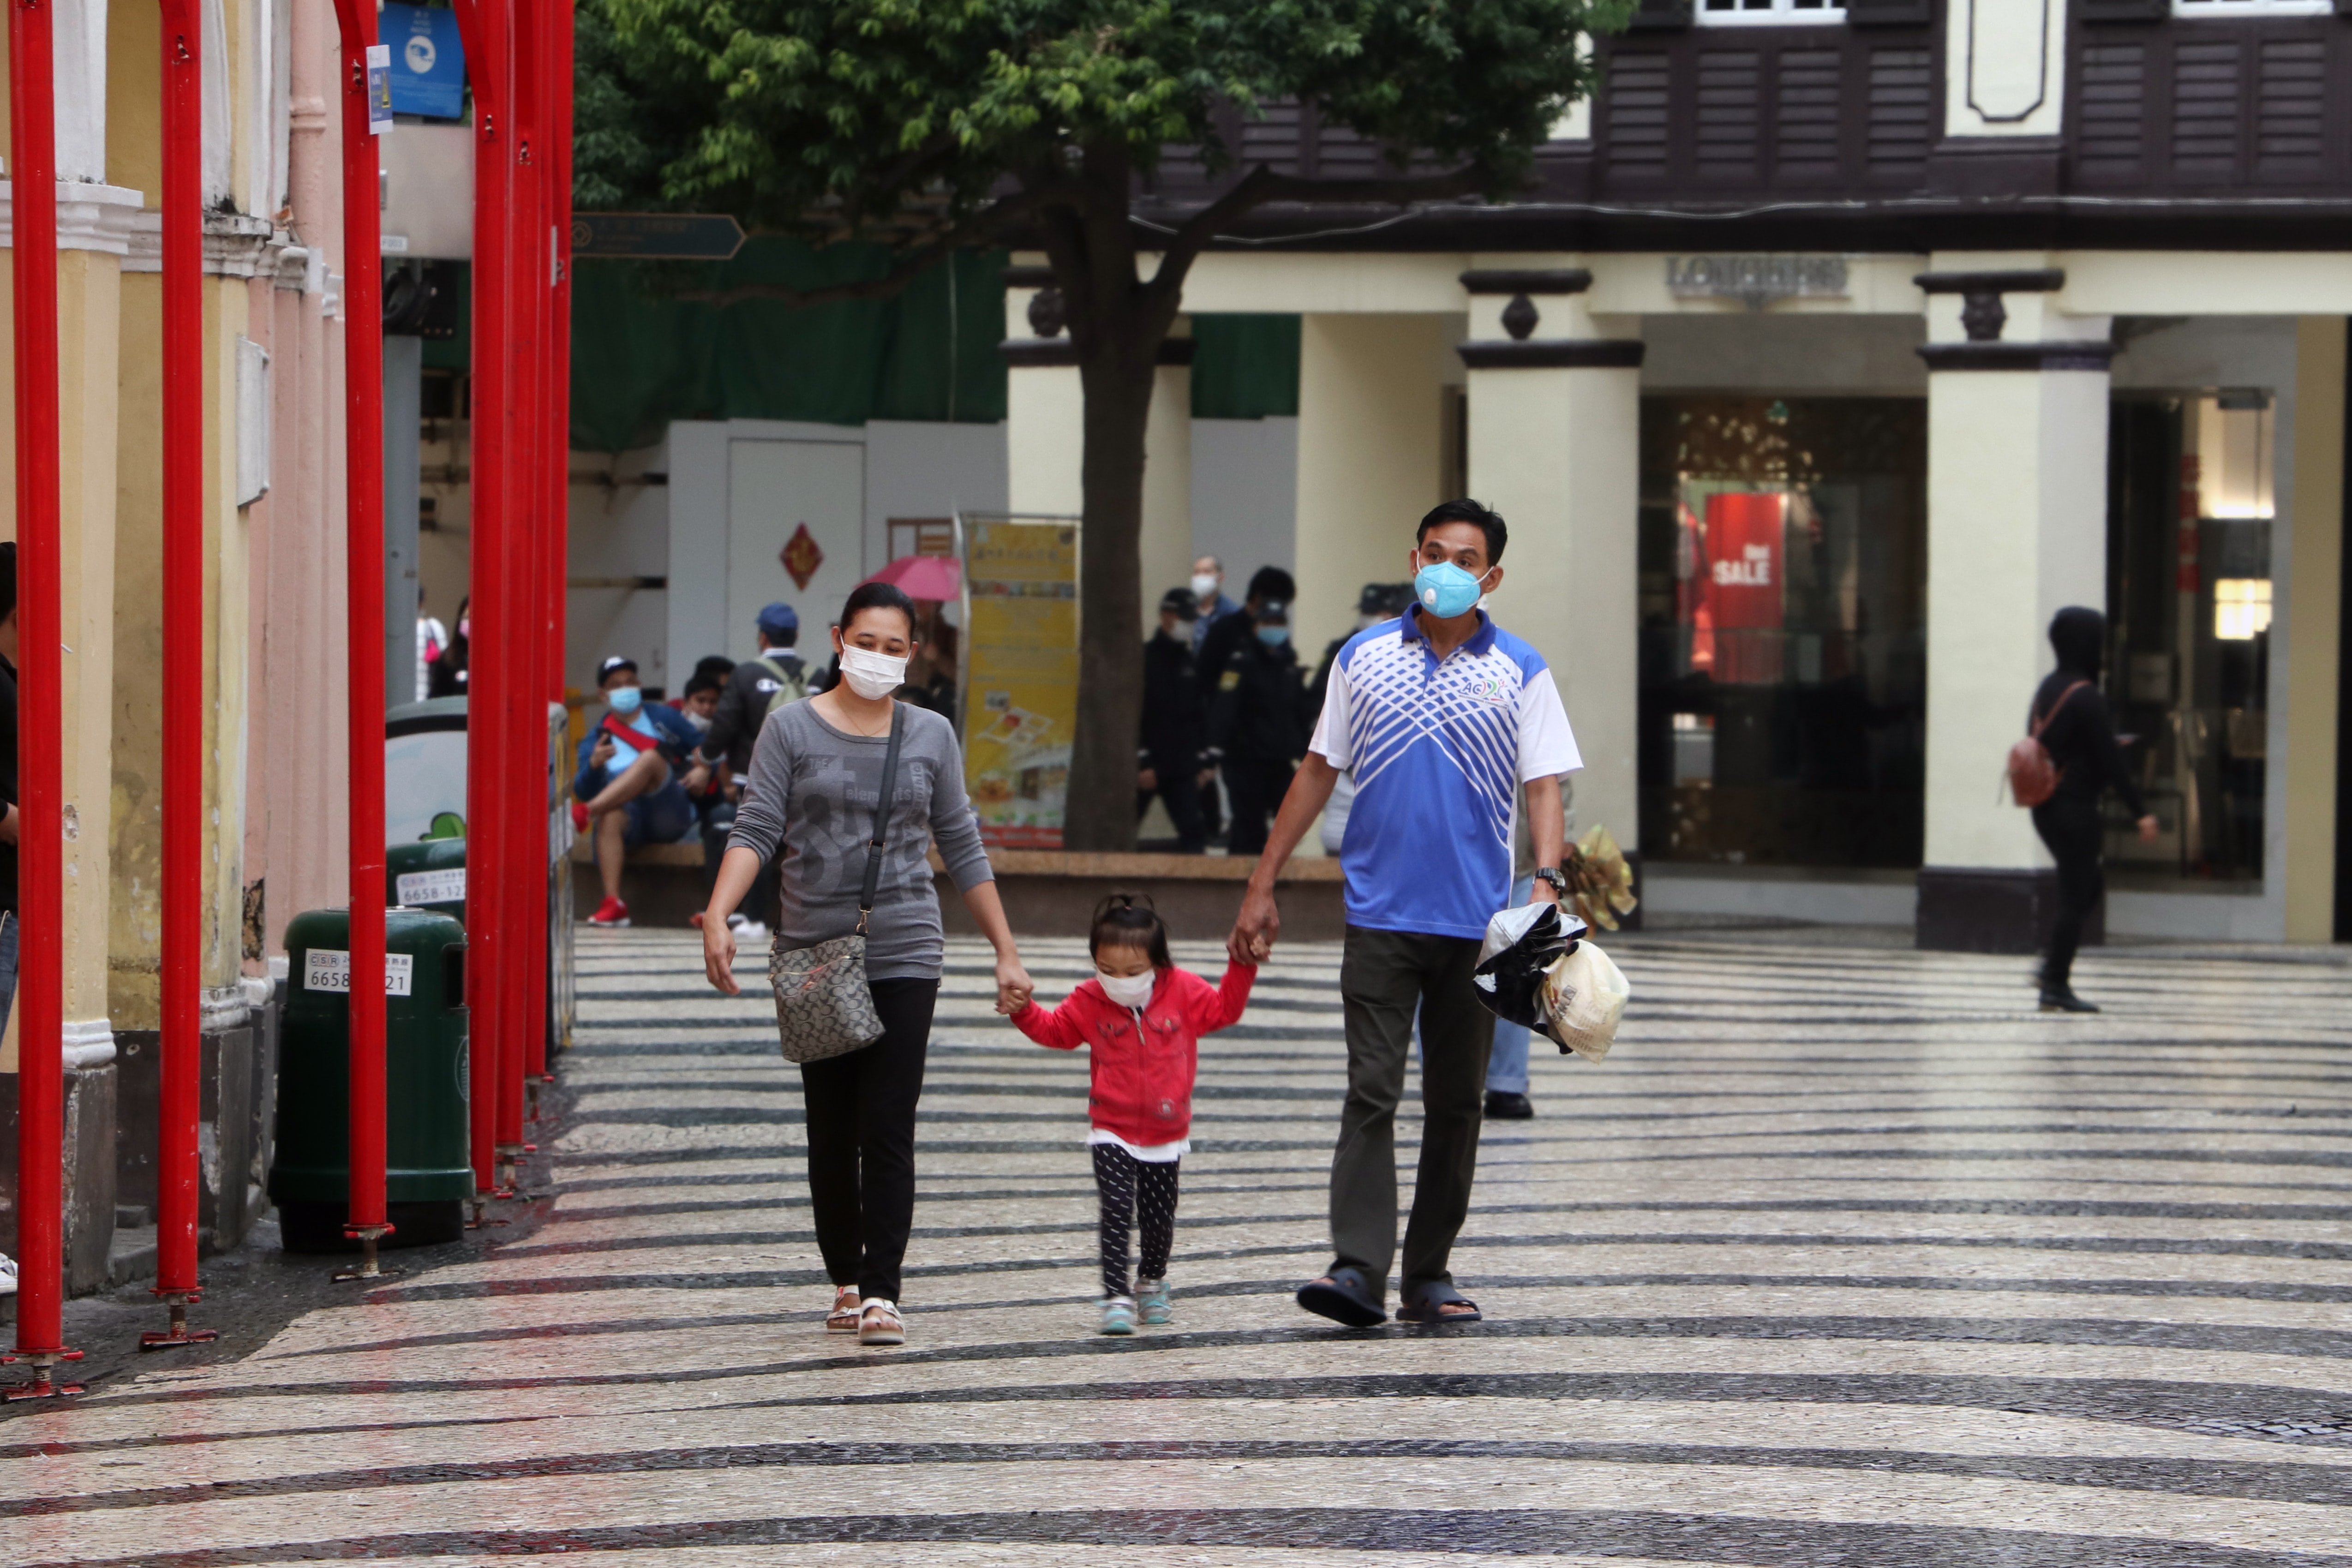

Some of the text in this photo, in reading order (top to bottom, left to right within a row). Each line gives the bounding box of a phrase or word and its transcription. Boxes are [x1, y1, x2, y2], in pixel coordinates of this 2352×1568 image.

[1713, 560, 1770, 585] SALE
[846, 787, 912, 802] elemts
[404, 886, 466, 902] 6658-12
[311, 955, 337, 965] CSR
